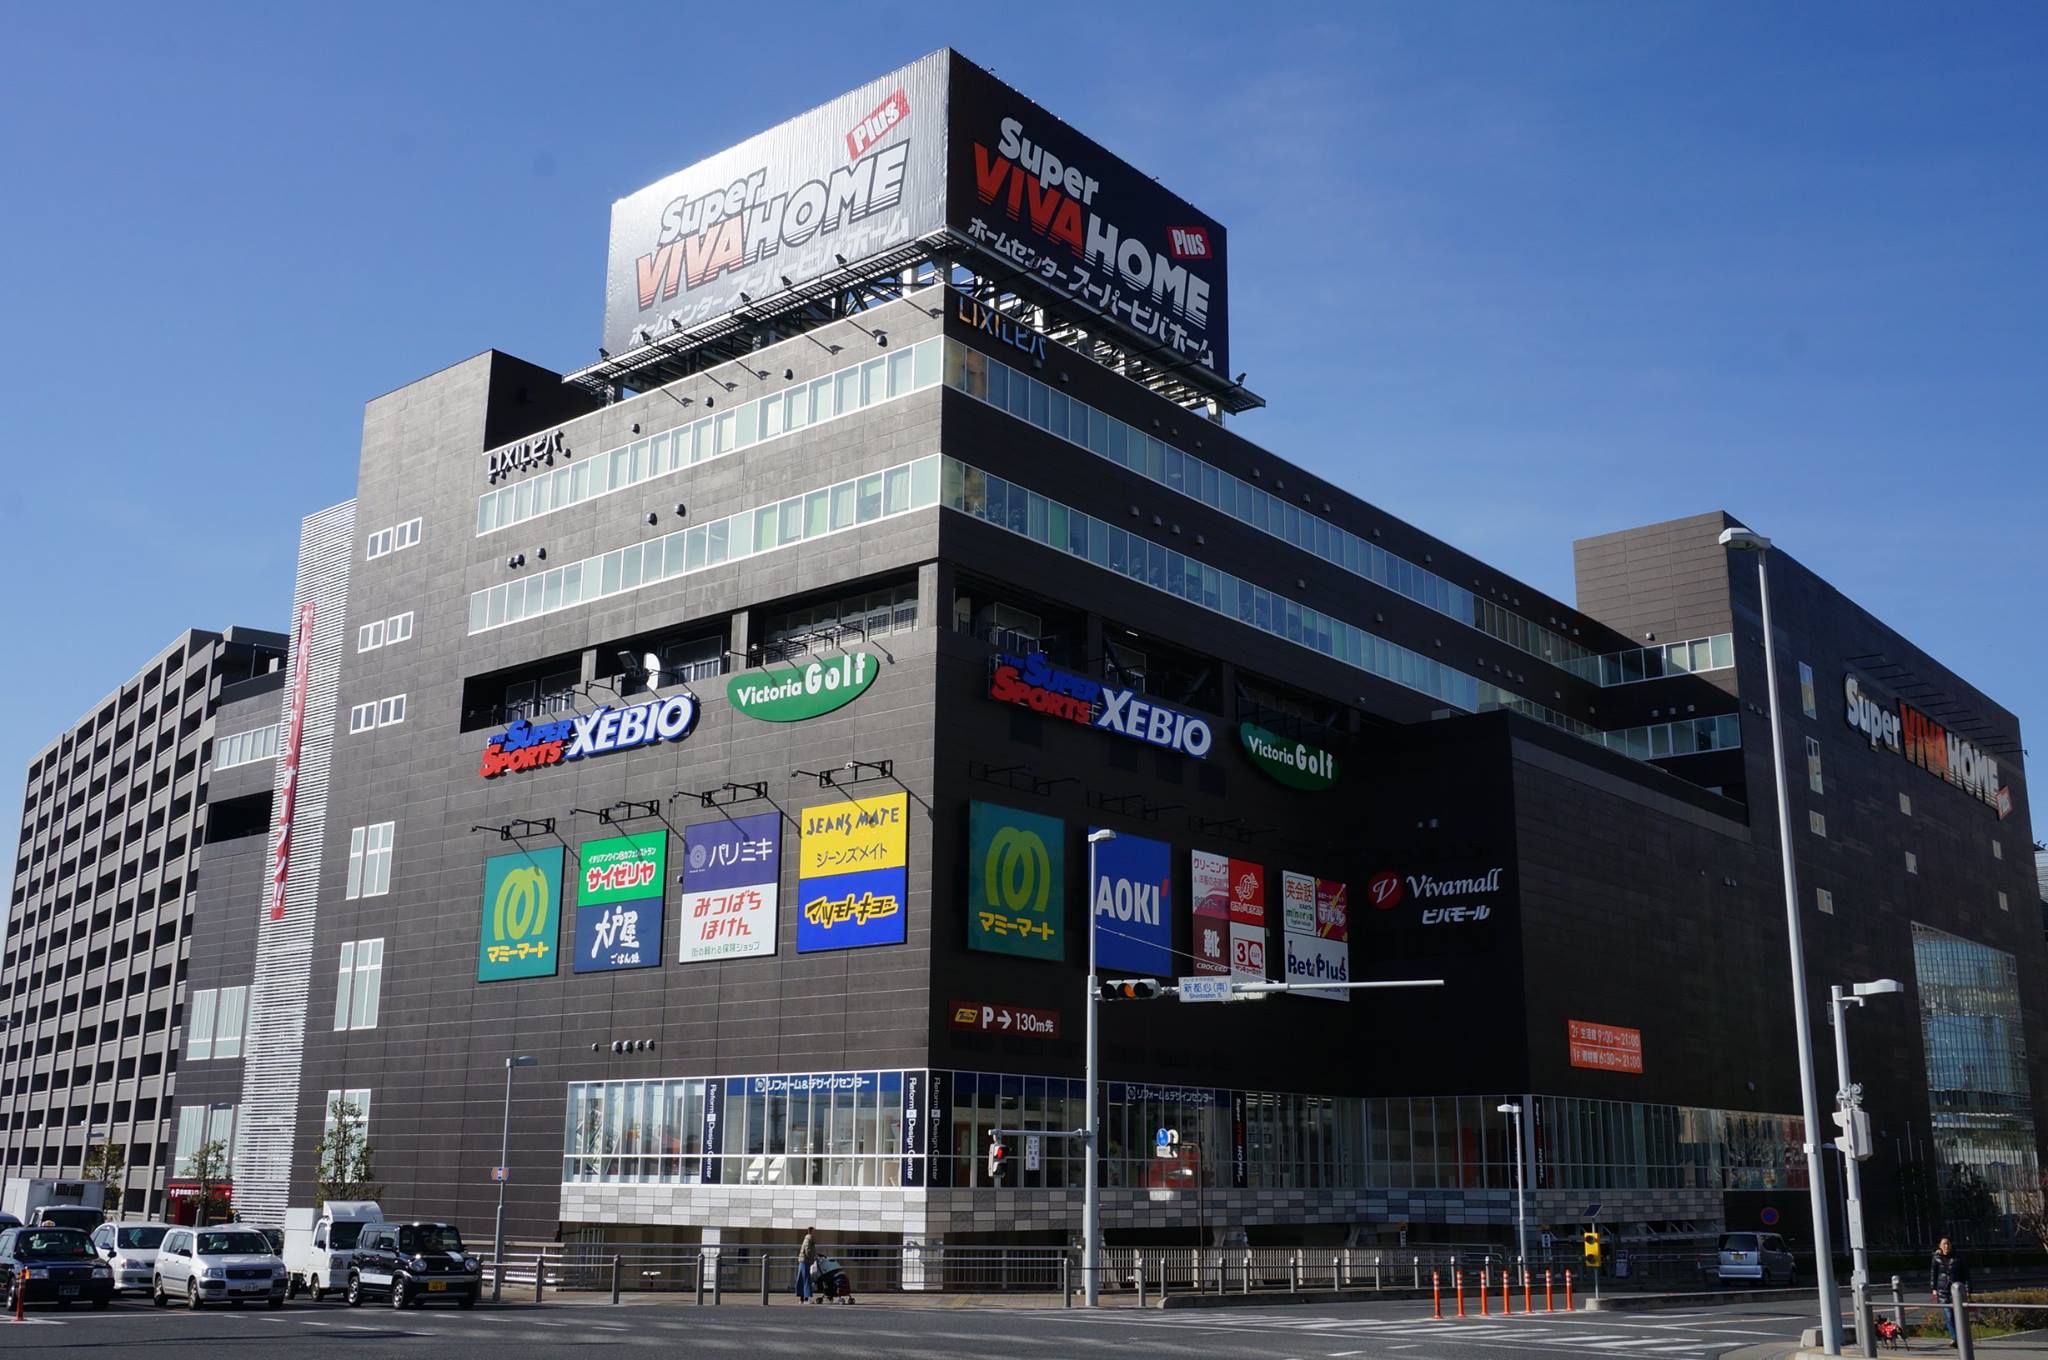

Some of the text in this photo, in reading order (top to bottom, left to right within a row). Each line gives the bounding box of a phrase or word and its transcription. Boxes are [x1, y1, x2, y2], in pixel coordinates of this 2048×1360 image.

[851, 99, 900, 153] Plus
[999, 117, 1100, 206] Super
[657, 166, 767, 247] Super
[1170, 229, 1207, 256] Plus
[967, 216, 1215, 370] ホームセンター スーパービバホーム
[959, 296, 1047, 360] LIXILビバ
[737, 652, 866, 707] Victoria Golf
[991, 665, 1091, 724] SPORTS
[1099, 686, 1212, 756] XEBIO
[1844, 672, 1900, 750] Super
[504, 719, 573, 752] SUPER
[567, 697, 695, 758] XEBIO
[479, 740, 564, 778] SPORTS
[1248, 736, 1334, 780] Victoria Golf
[806, 807, 900, 837] JEANS MATE
[708, 837, 773, 868] パリミキ
[815, 841, 888, 868] ジーンズメイト
[1193, 858, 1228, 874] クリーニング
[587, 861, 656, 893] サイゼリヤ
[1286, 879, 1313, 903] 英会話
[1406, 867, 1503, 899] Vivamall
[693, 890, 762, 918] みつばち
[805, 892, 897, 927] マツモトキヨシ
[1095, 875, 1161, 926] AOKI
[1421, 904, 1491, 925] ビバモール
[591, 905, 640, 960] 大戸屋
[700, 916, 752, 941] ほけん
[977, 910, 1056, 942] マミーマート
[487, 940, 550, 964] マミーマート
[1204, 929, 1221, 958] 靴
[1288, 953, 1347, 982] Pet Plus
[982, 1006, 995, 1030] P
[709, 1084, 717, 1113] Reform
[908, 1077, 917, 1109] Reform
[932, 1077, 941, 1108] Reform
[706, 1122, 715, 1154] Design
[906, 1118, 915, 1152] Design
[931, 1118, 940, 1152] Design
[705, 1154, 713, 1179] Center
[905, 1152, 914, 1181] Center
[930, 1152, 939, 1181] Center
